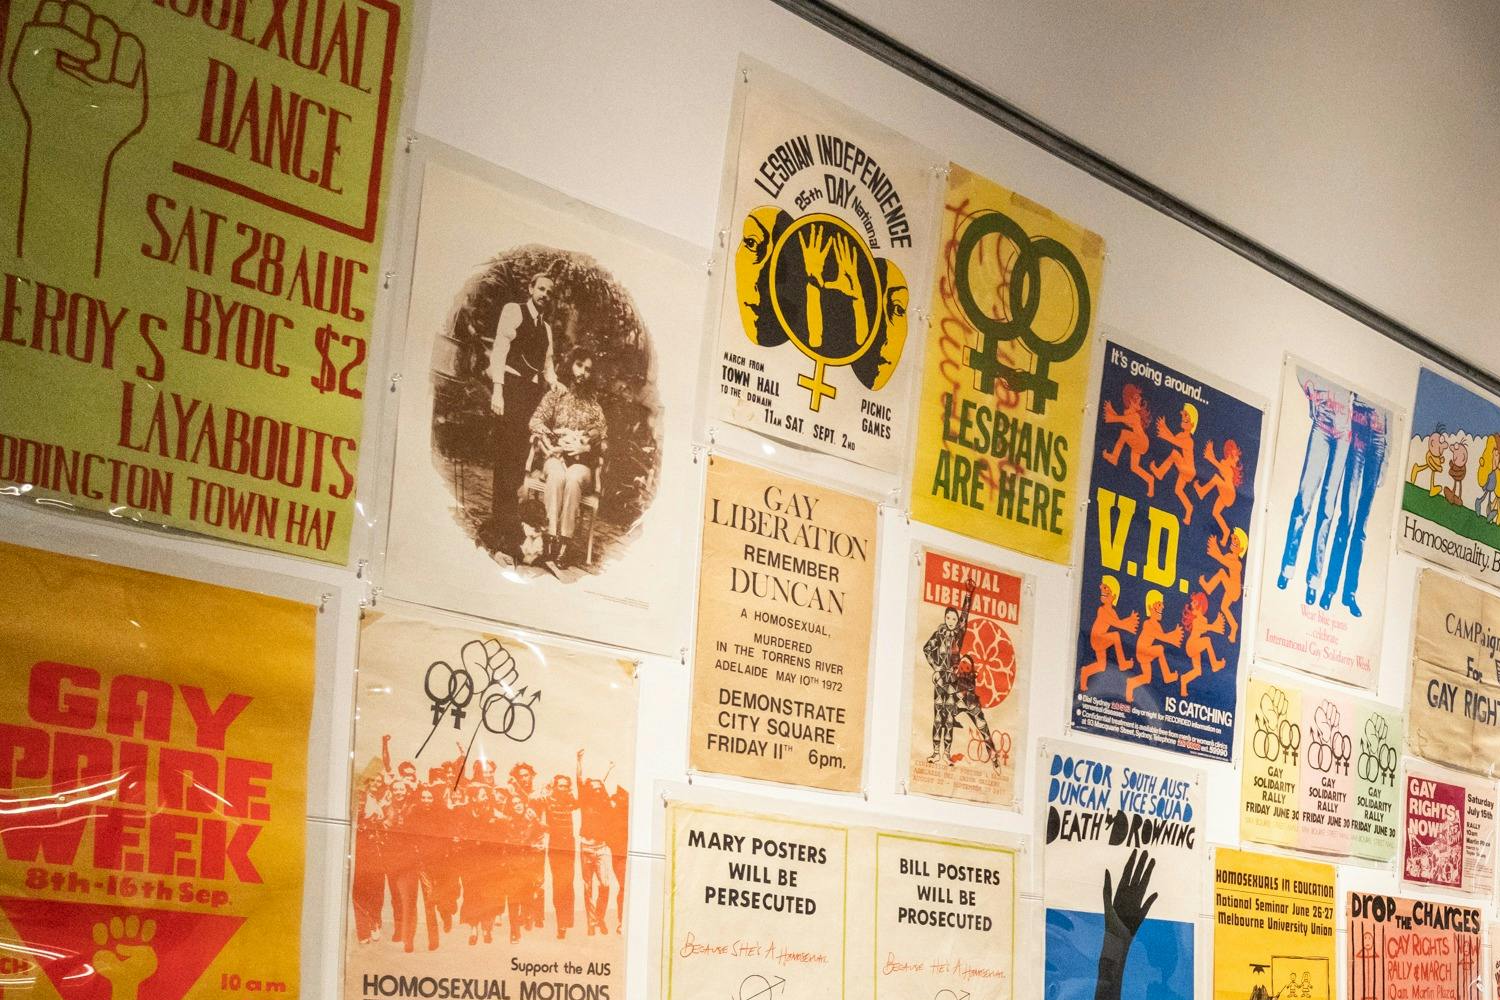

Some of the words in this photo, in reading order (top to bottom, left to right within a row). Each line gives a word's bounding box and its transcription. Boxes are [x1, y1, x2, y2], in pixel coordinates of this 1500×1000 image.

[196, 57, 351, 195] DANCE
[754, 135, 813, 198] LESBIAN
[815, 133, 913, 249] INDEPENDENCE
[823, 173, 855, 208] DAY
[851, 196, 880, 250] National
[142, 194, 227, 275] SAT
[230, 225, 285, 297] 28
[286, 253, 368, 323] AUG
[722, 365, 750, 387] TOWN
[757, 377, 780, 397] HALL
[1130, 357, 1162, 387] going
[861, 399, 891, 422] PICNIC
[118, 381, 357, 499] LAYABOUTS
[862, 418, 891, 440] GAMES
[941, 392, 1069, 484] LESBIANS
[764, 485, 820, 521] GAY
[931, 454, 985, 513] ARE
[997, 474, 1065, 535] HERE
[711, 498, 868, 563] LIBERATION
[1096, 486, 1190, 594] V.D.
[744, 544, 840, 583] REMEMBER
[942, 561, 1000, 593] SEXUAL
[730, 566, 846, 615] DUNCAN
[753, 633, 812, 654] MURDERED
[715, 660, 768, 679] ADELAIDE
[762, 649, 811, 669] TORRENS
[815, 660, 844, 676] RIVER
[27, 660, 255, 750] GAY
[719, 688, 846, 724] DEMONSTRATE
[1165, 696, 1177, 713] IS
[1178, 699, 1233, 727] CATCHING
[1427, 679, 1458, 712] GAY
[718, 712, 760, 734] CITY
[767, 720, 836, 745] SQUARE
[0, 723, 273, 821] PRIDE
[1050, 754, 1112, 788] DOCTOR
[1121, 767, 1157, 796] SOUTH
[1254, 774, 1296, 793] SOLIDARITY
[1267, 766, 1283, 778] GAY
[1120, 790, 1146, 815] VICE
[1148, 797, 1193, 823] SQUAD
[1046, 806, 1101, 845] DEATH
[1108, 810, 1196, 850] DROWNING
[0, 805, 264, 885] WEEK
[688, 829, 744, 852] MARY
[751, 838, 827, 865] POSTERS
[728, 862, 771, 884] WILL
[778, 870, 798, 888] BE
[899, 858, 930, 878] BILL
[937, 864, 1000, 886] POSTERS
[705, 886, 817, 916] PERSECUTED
[917, 885, 953, 905] WILL
[959, 890, 976, 907] BE
[1294, 881, 1334, 898] EDUCATION
[898, 907, 992, 932] PROSECUTED
[1255, 899, 1289, 914] Seminar
[1292, 902, 1310, 916] June
[1268, 918, 1307, 937] University
[1311, 923, 1333, 936] Union
[511, 957, 558, 976] Support
[564, 961, 583, 974] the
[587, 962, 611, 976] AUS
[363, 974, 511, 1000] HOMOSEXUAL
